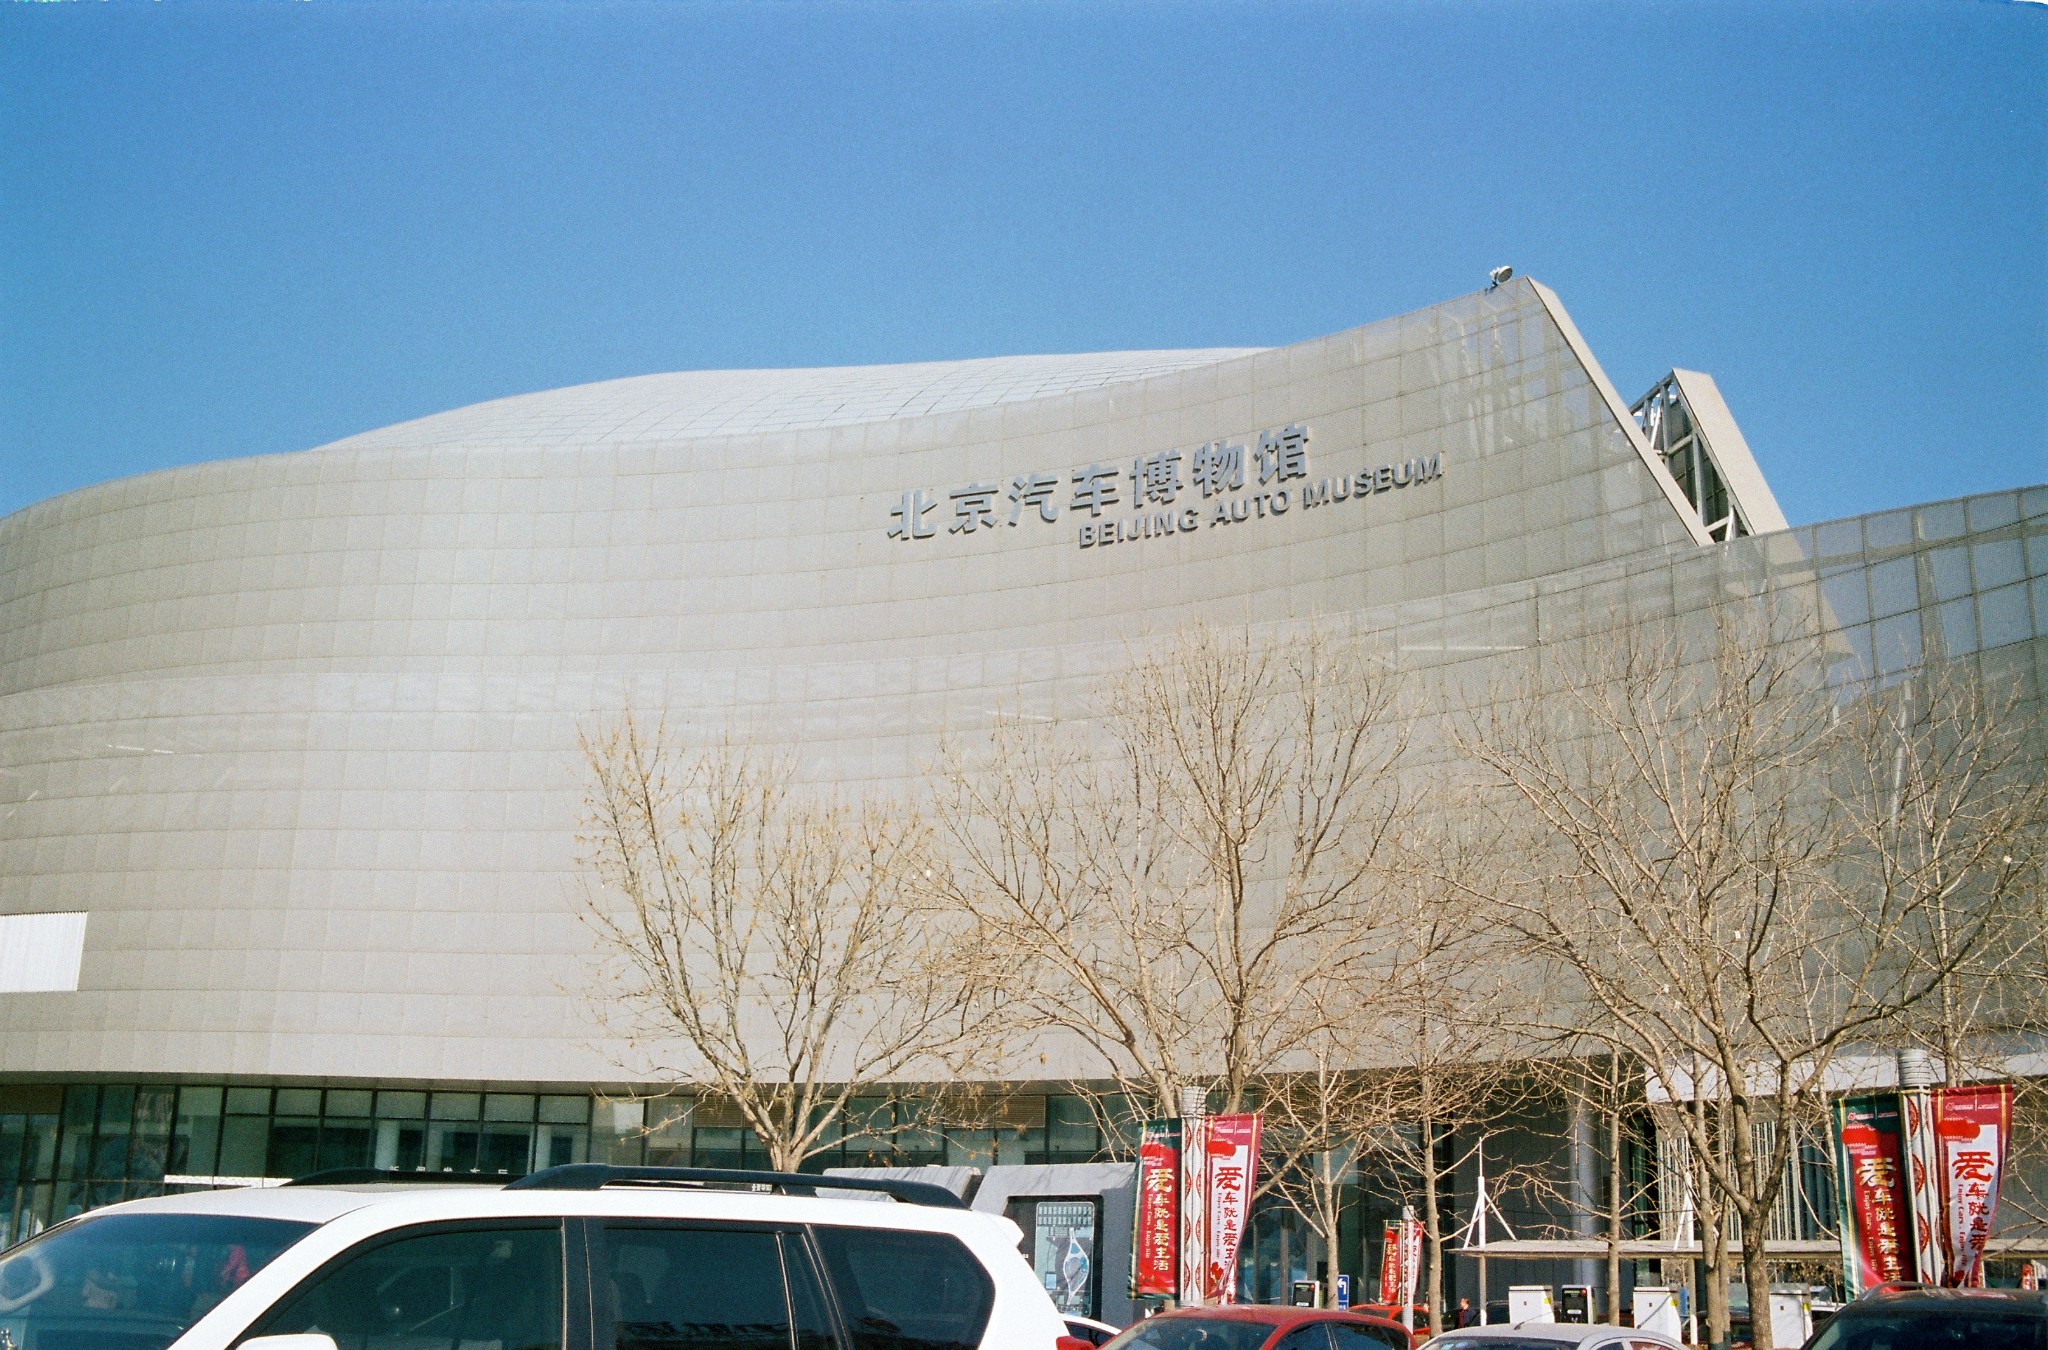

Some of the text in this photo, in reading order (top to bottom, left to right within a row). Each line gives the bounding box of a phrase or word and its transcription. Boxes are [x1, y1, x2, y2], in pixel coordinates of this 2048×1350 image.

[887, 422, 1309, 540] 北京汽车博物馆
[1080, 452, 1443, 549] BEIJING AUTO MUSEUM
[1146, 1168, 1175, 1271] 爱车就是爱生活
